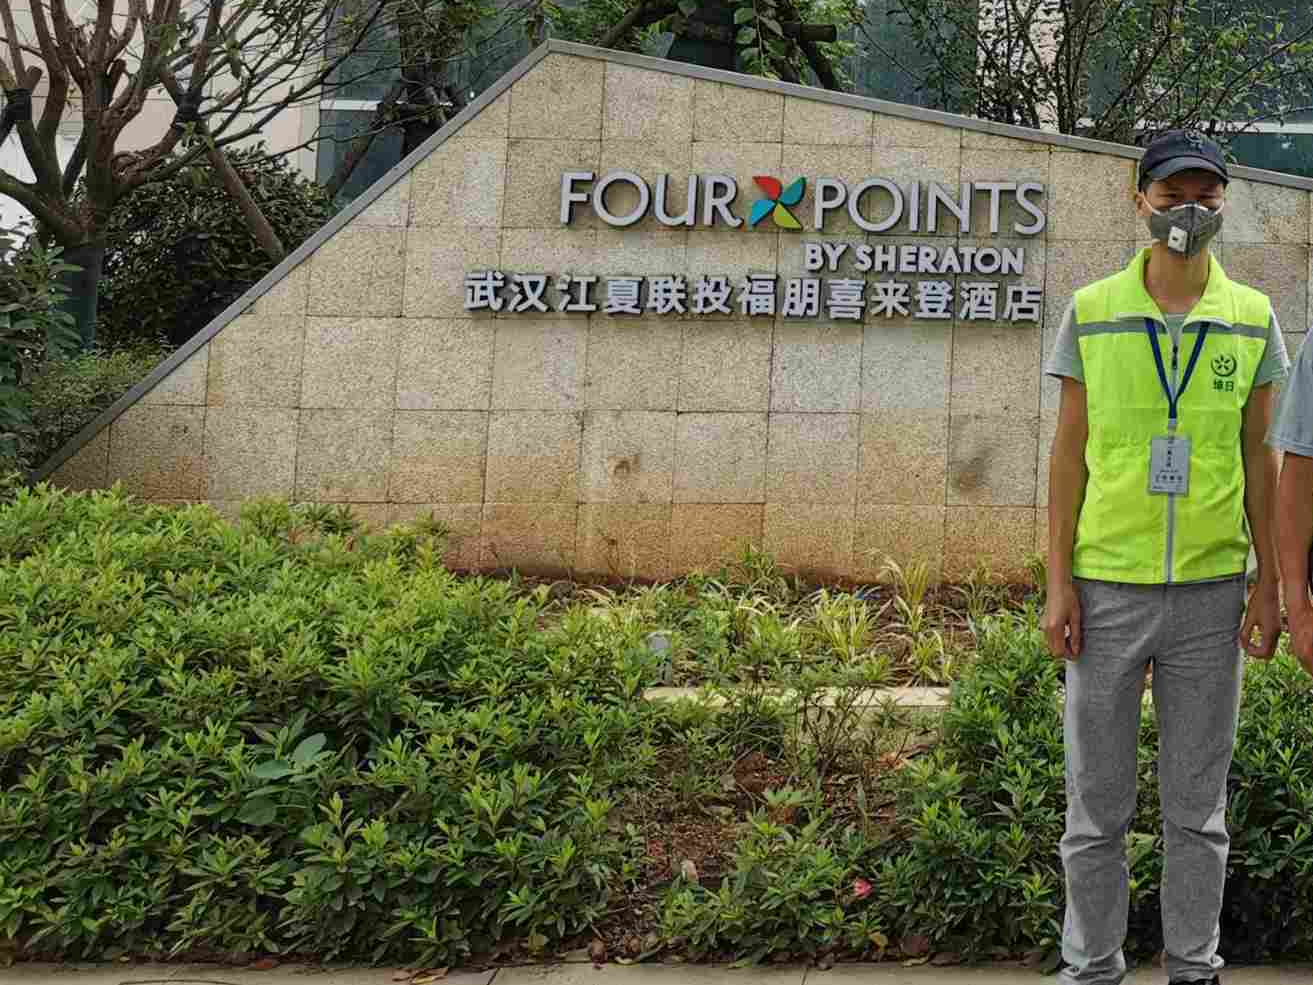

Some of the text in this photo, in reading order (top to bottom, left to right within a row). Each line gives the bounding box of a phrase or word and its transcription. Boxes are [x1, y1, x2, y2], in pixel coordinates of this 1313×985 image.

[559, 170, 1047, 235] FOUR POINTS
[804, 243, 1025, 275] BY SHERATON
[464, 270, 1043, 322] 武汉江夏联投福朋喜来登酒店
